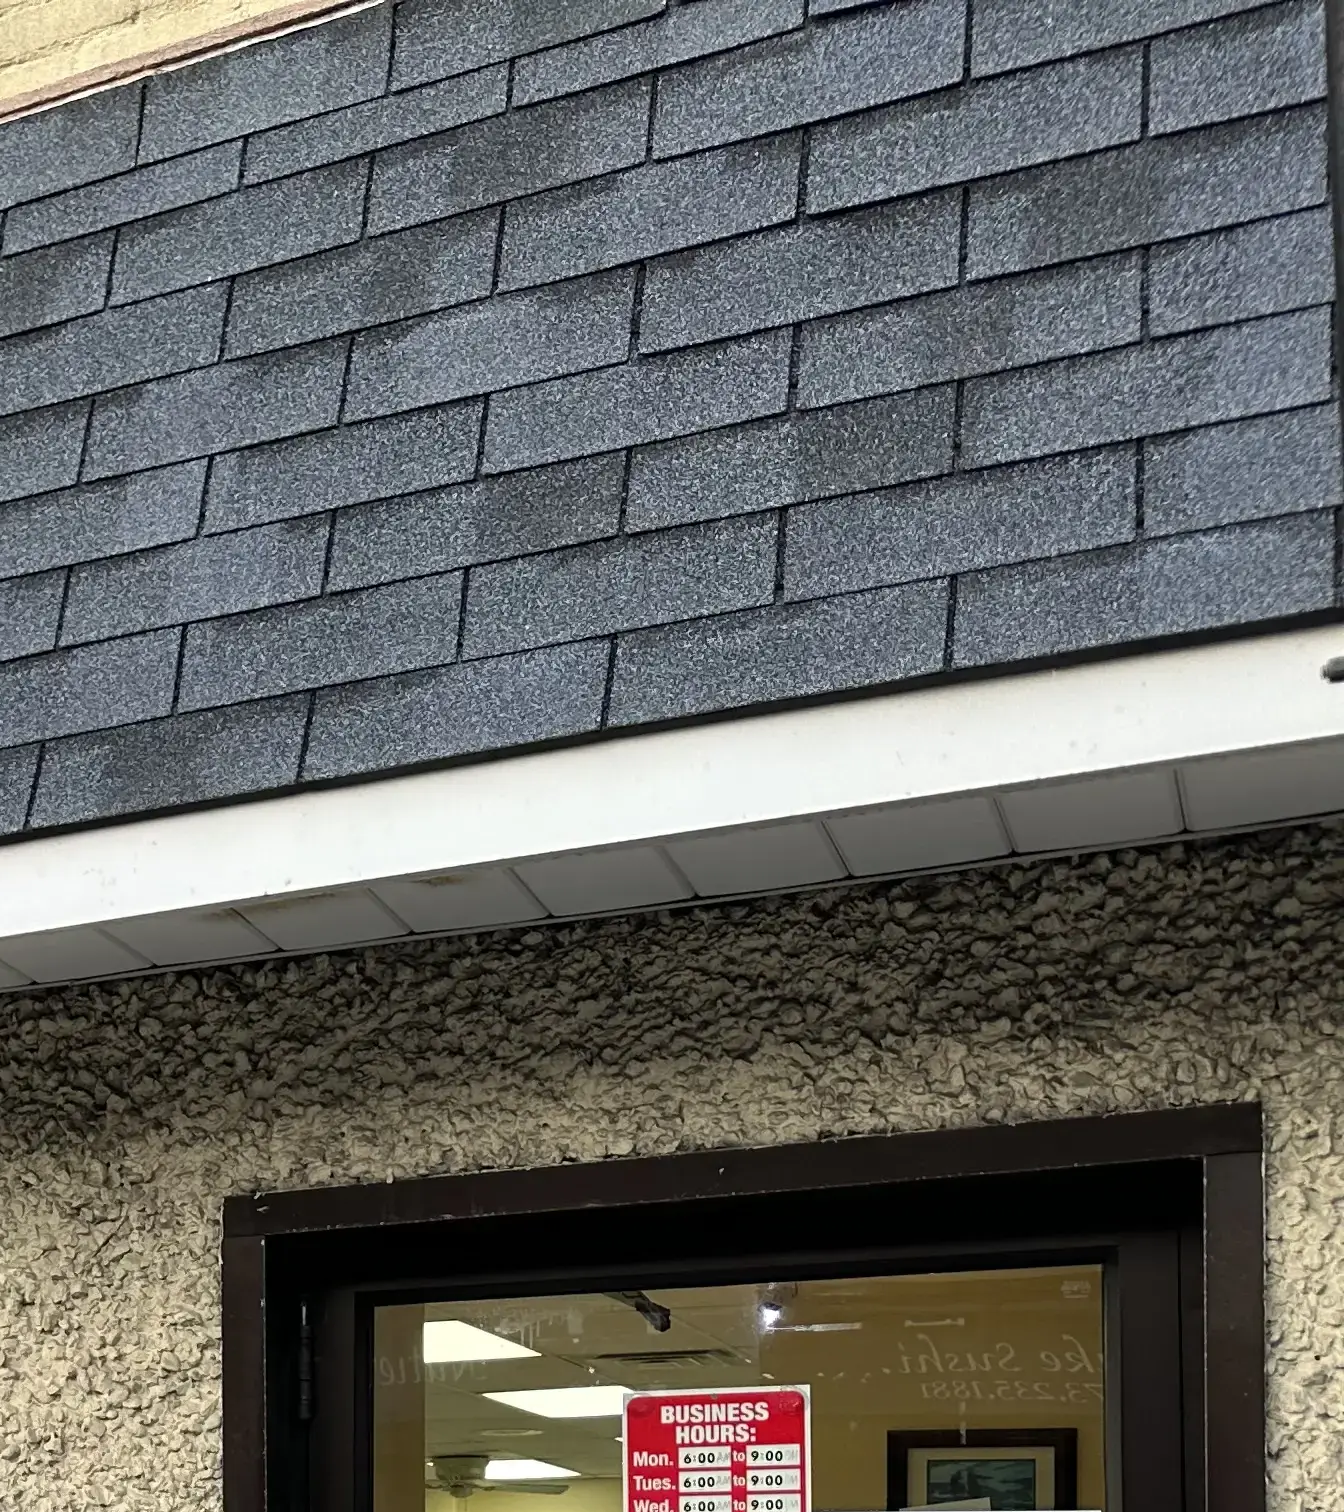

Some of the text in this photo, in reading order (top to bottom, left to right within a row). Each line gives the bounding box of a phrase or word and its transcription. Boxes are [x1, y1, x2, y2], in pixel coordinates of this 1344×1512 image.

[661, 1402, 769, 1424] BUSINESS
[675, 1424, 757, 1444] HOURS:
[633, 1451, 674, 1467] Mon.
[683, 1452, 715, 1464] 6:00
[733, 1450, 745, 1461] to
[751, 1450, 783, 1462] 9:00
[633, 1475, 676, 1491] Tues.
[683, 1476, 715, 1488] 6:00
[733, 1475, 745, 1486] to
[751, 1474, 783, 1486] 9:00
[683, 1501, 715, 1512] 6:00
[733, 1500, 746, 1511] to
[751, 1499, 783, 1510] 9:00
